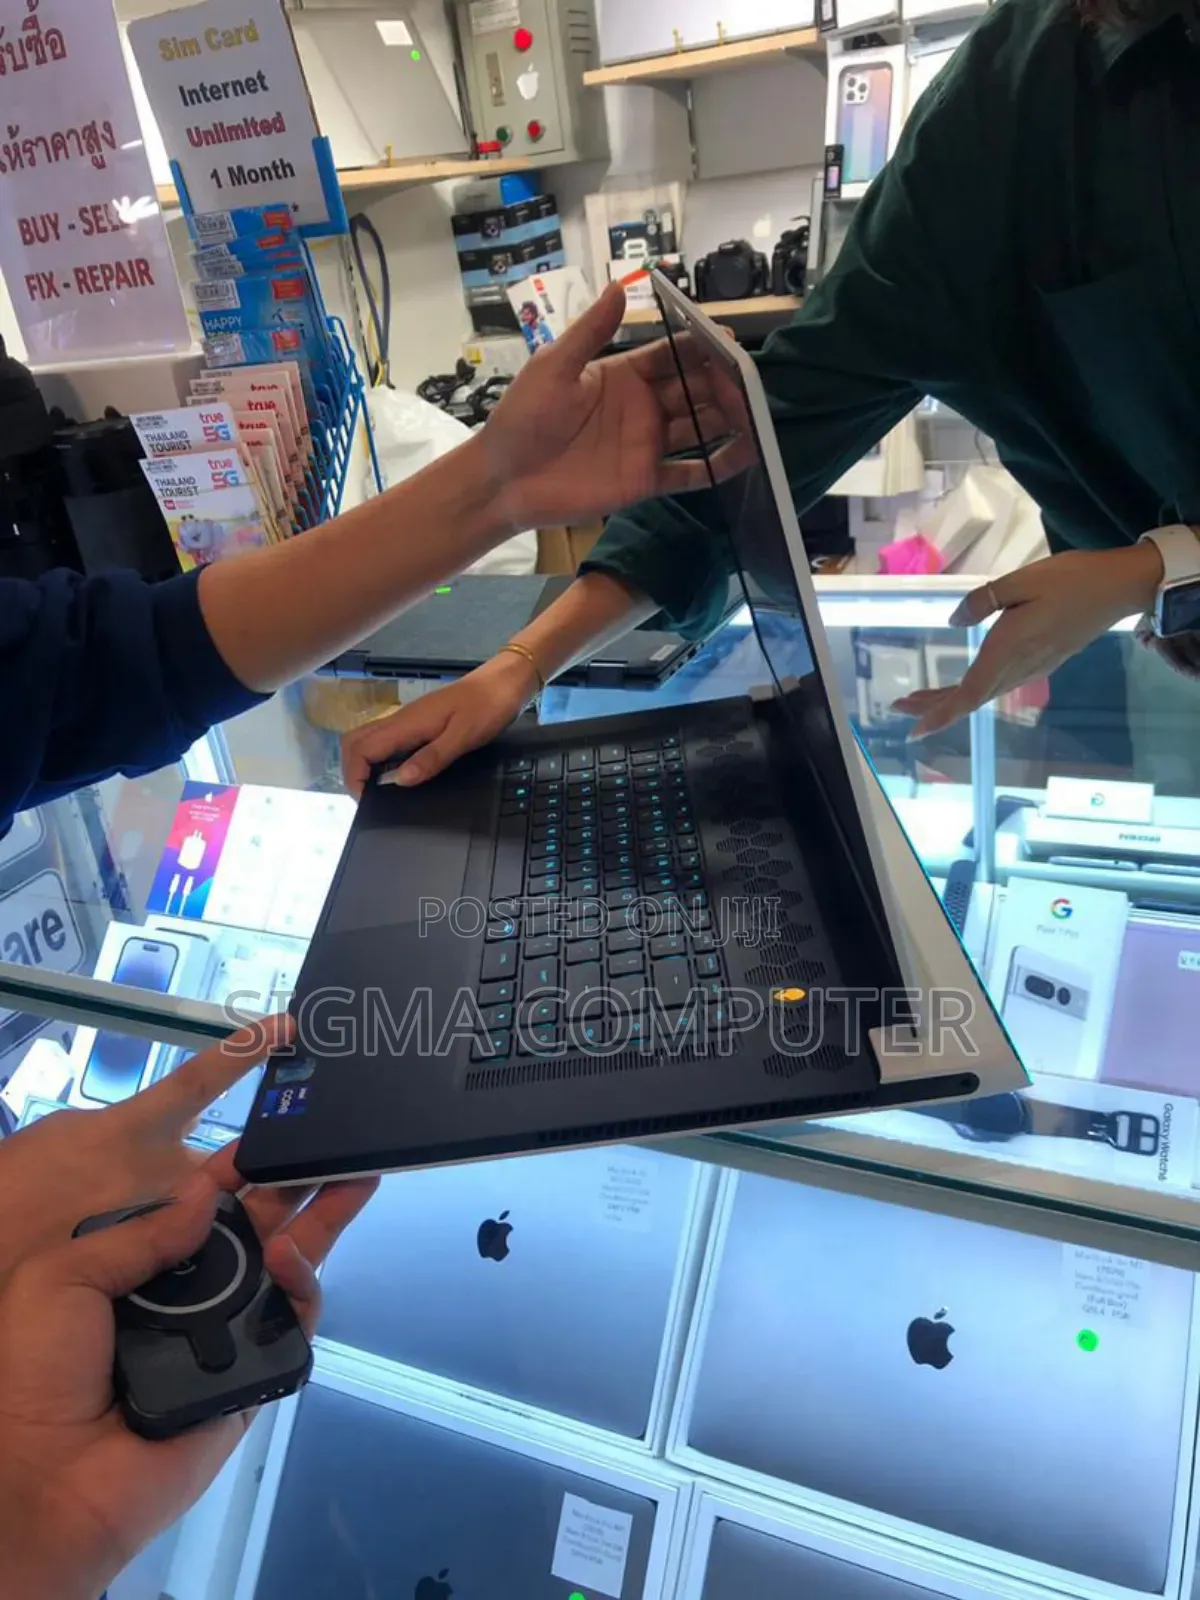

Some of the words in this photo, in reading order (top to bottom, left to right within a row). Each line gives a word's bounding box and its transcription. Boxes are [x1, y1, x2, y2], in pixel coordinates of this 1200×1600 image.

[158, 37, 202, 61] Sim
[204, 18, 260, 51] Card
[178, 70, 270, 107] Internet
[186, 111, 286, 148] Unlimited
[210, 168, 223, 189] 1
[227, 157, 296, 188] Month
[18, 212, 61, 246] BUY
[24, 271, 60, 301] FIX
[73, 258, 155, 295] REPAIR
[204, 315, 242, 330] HAPPY
[199, 412, 225, 424] true
[144, 430, 188, 442] THAILAND
[202, 424, 232, 443] 5G
[149, 440, 192, 453] TOURIST
[207, 458, 233, 470] true
[154, 476, 197, 487] THAILAND
[211, 470, 240, 490] 5G
[159, 485, 200, 498] TOURIST
[1159, 1103, 1174, 1140] Galaxy
